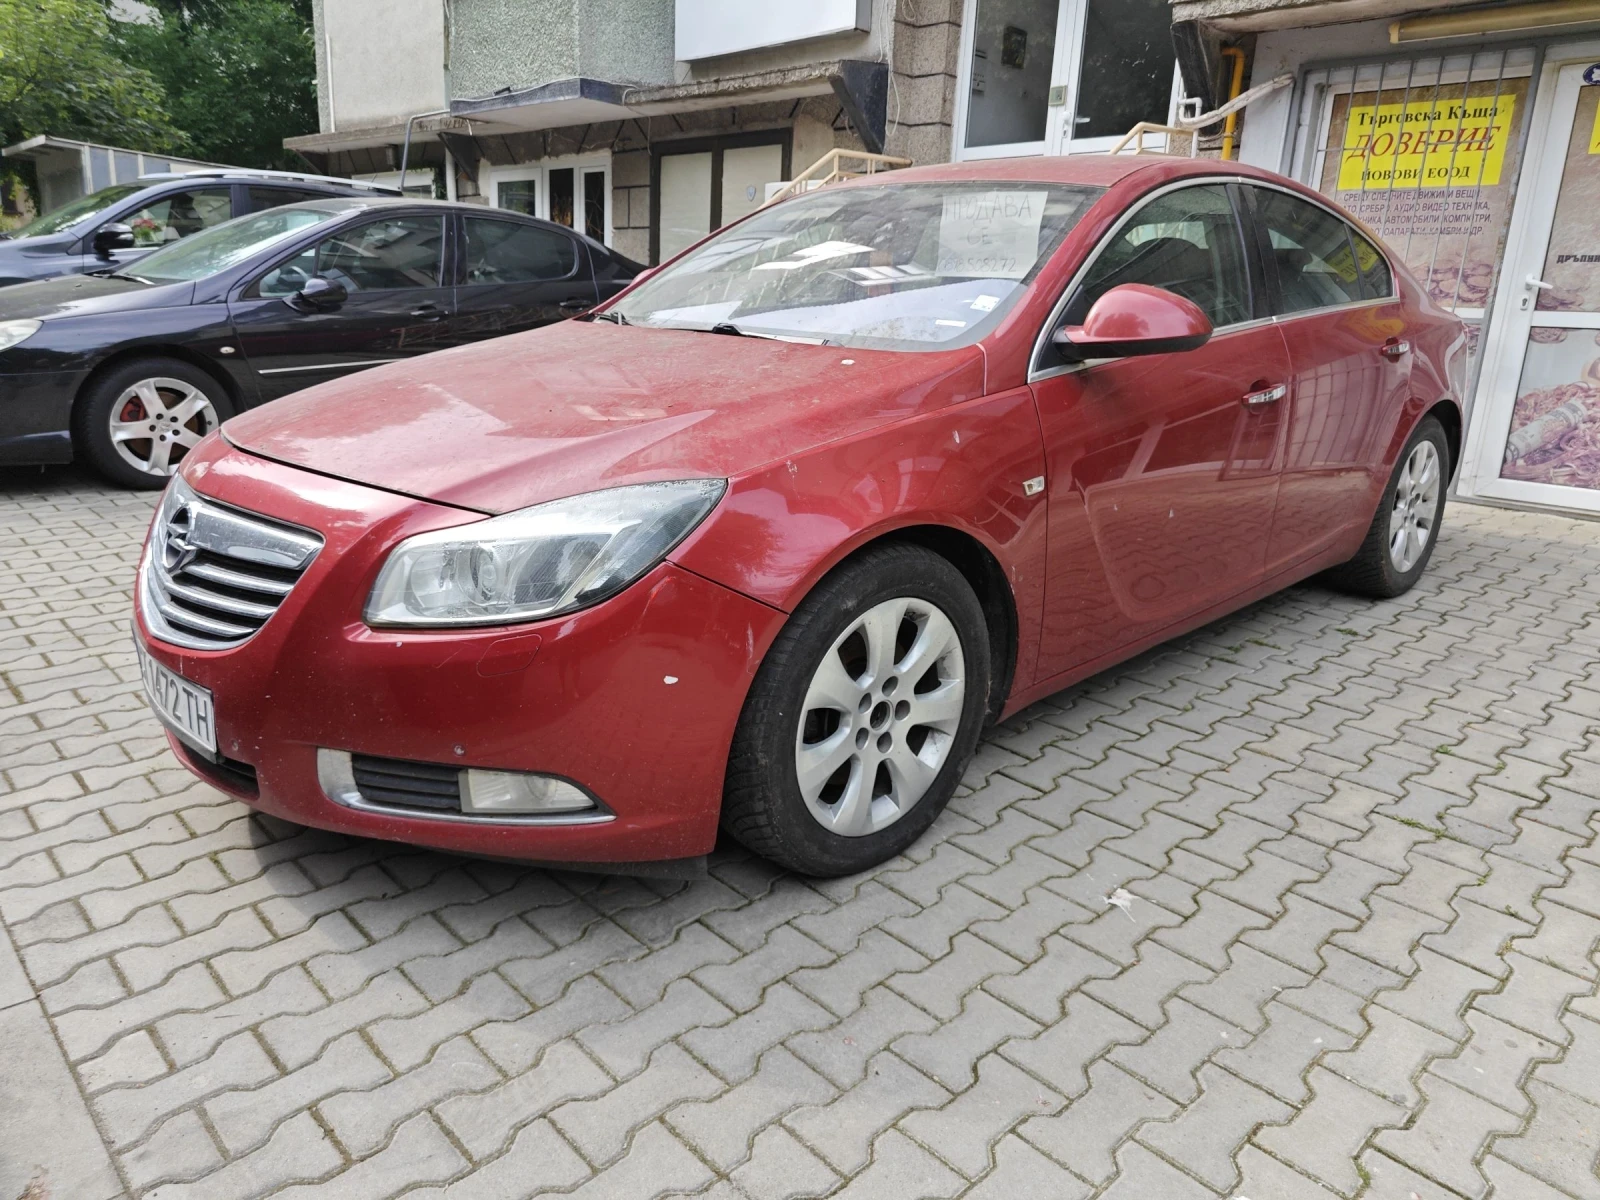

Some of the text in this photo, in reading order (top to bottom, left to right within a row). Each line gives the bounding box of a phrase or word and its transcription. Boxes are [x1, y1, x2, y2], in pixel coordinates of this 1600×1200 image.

[1358, 105, 1498, 129] Търговска Къща
[1345, 126, 1502, 164] ДОВЕРИЕ
[1427, 166, 1471, 179] ЕООД
[1371, 190, 1413, 202] СЛЕНИТЕ
